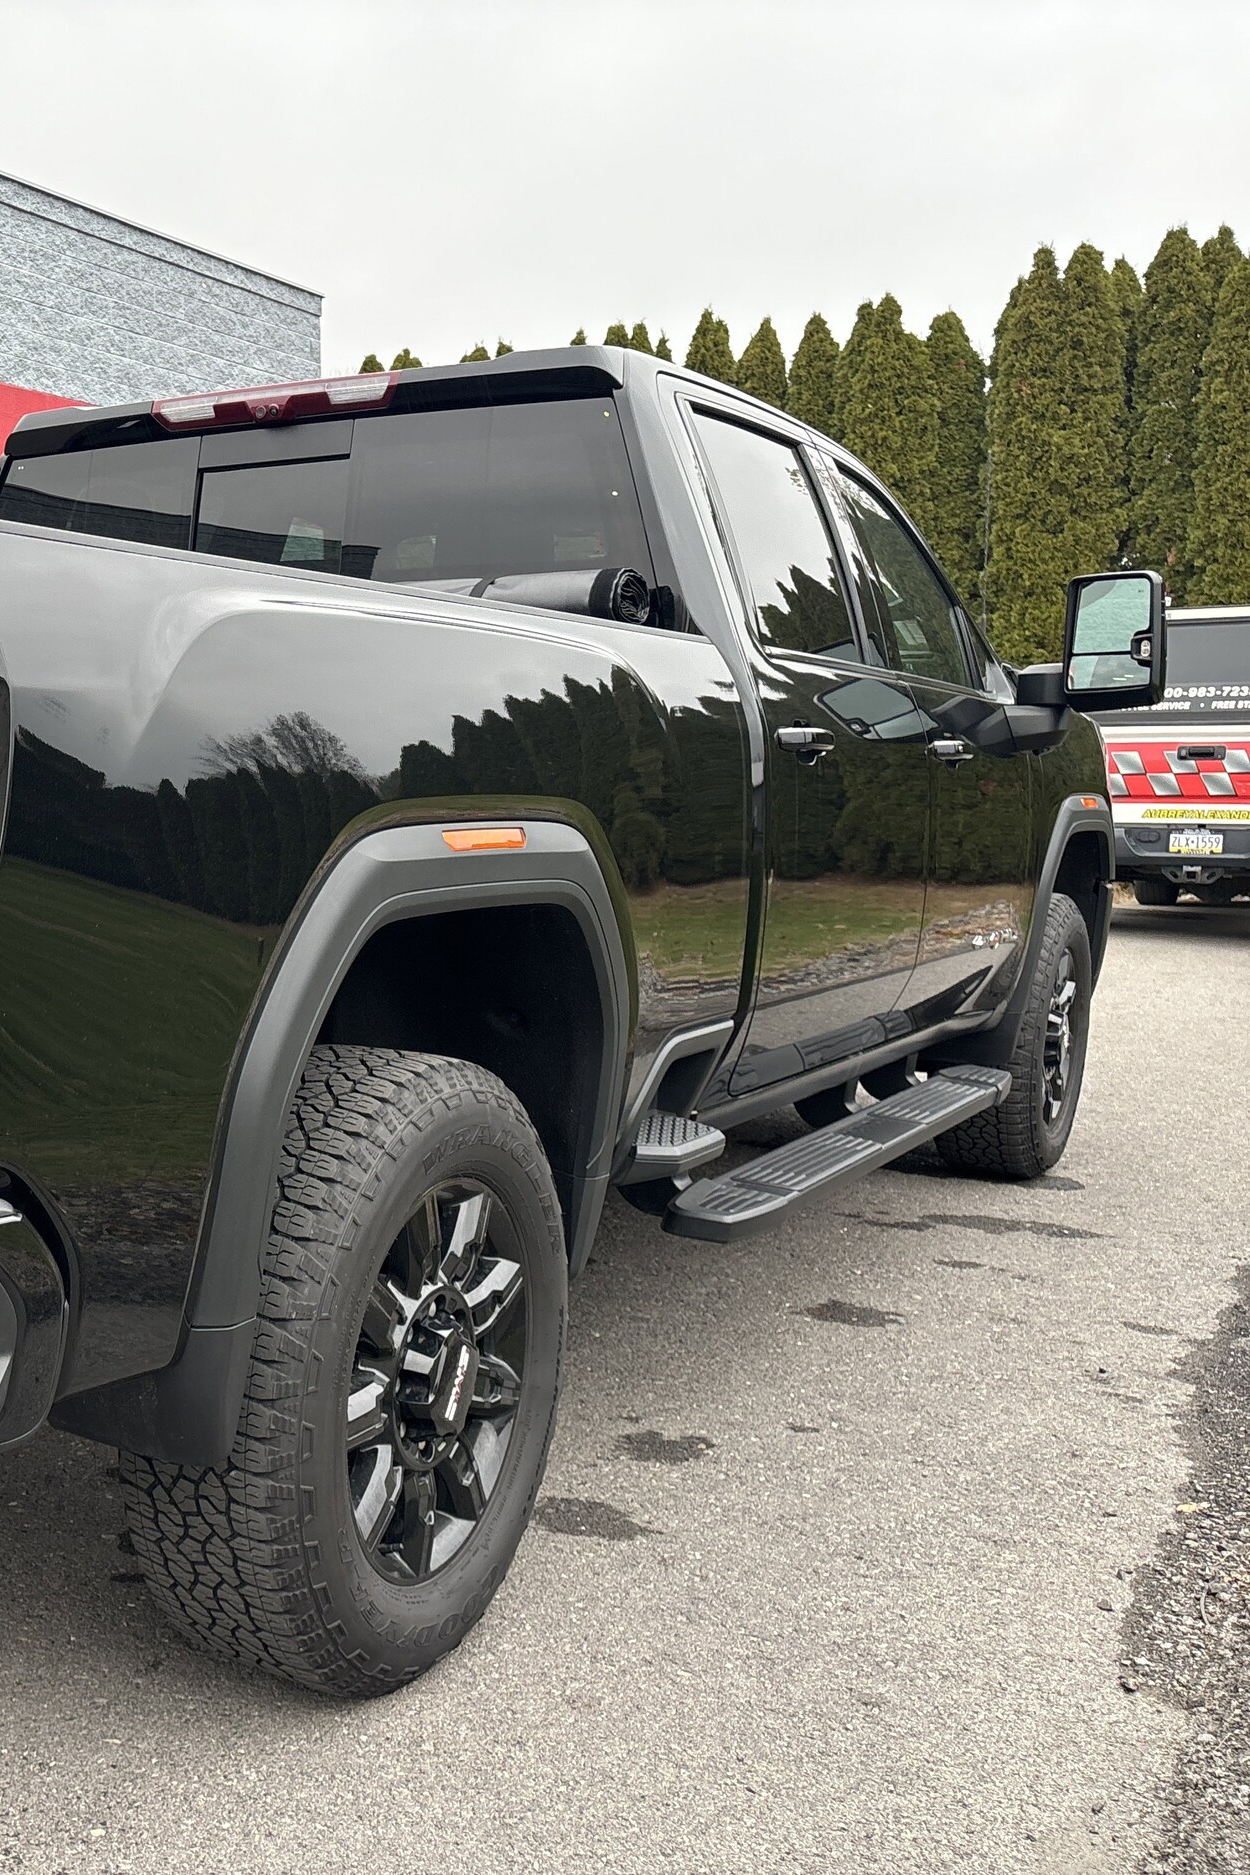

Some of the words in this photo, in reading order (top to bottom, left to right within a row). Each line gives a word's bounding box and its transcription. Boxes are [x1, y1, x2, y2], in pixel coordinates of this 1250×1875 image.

[1164, 686, 1250, 698] 00-983-723
[1211, 701, 1235, 709] FREE
[422, 1123, 561, 1256] WRANGLER
[337, 1527, 499, 1649] GOODYEAR
